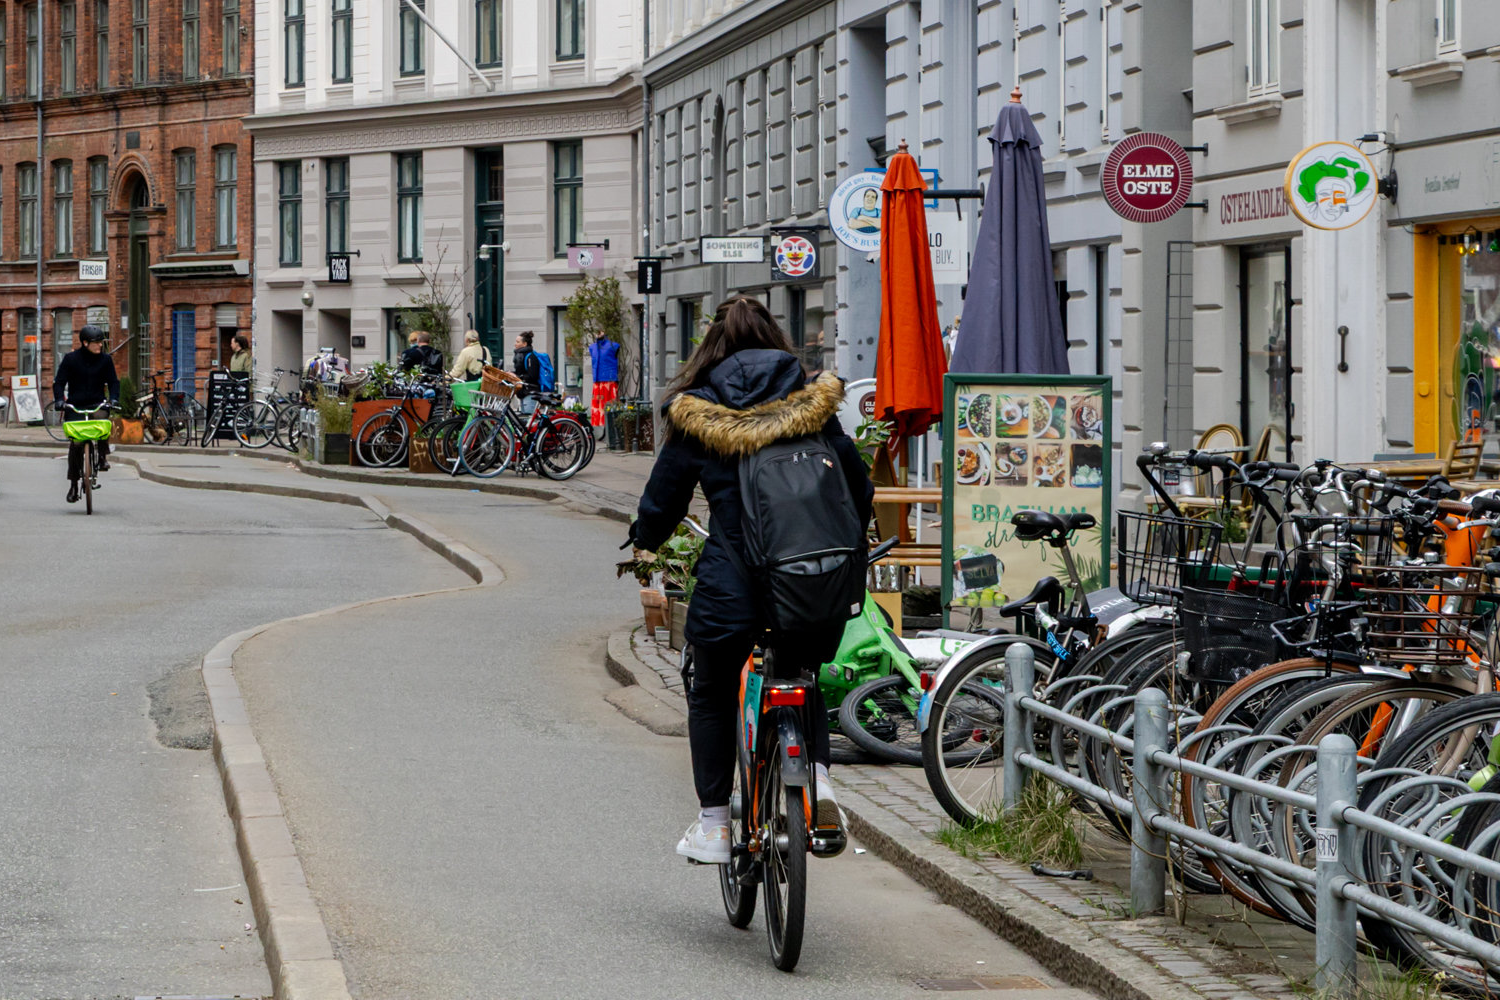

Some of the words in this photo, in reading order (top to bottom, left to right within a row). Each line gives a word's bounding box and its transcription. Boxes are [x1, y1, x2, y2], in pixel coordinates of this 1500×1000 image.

[1122, 164, 1175, 178] ELME
[1123, 181, 1173, 195] OSTE
[836, 226, 859, 244] JOE'S
[860, 238, 881, 247] BUR
[706, 241, 759, 250] SOMETHING
[723, 250, 743, 258] ELSE
[331, 258, 347, 270] PACK
[332, 270, 348, 280] YARD
